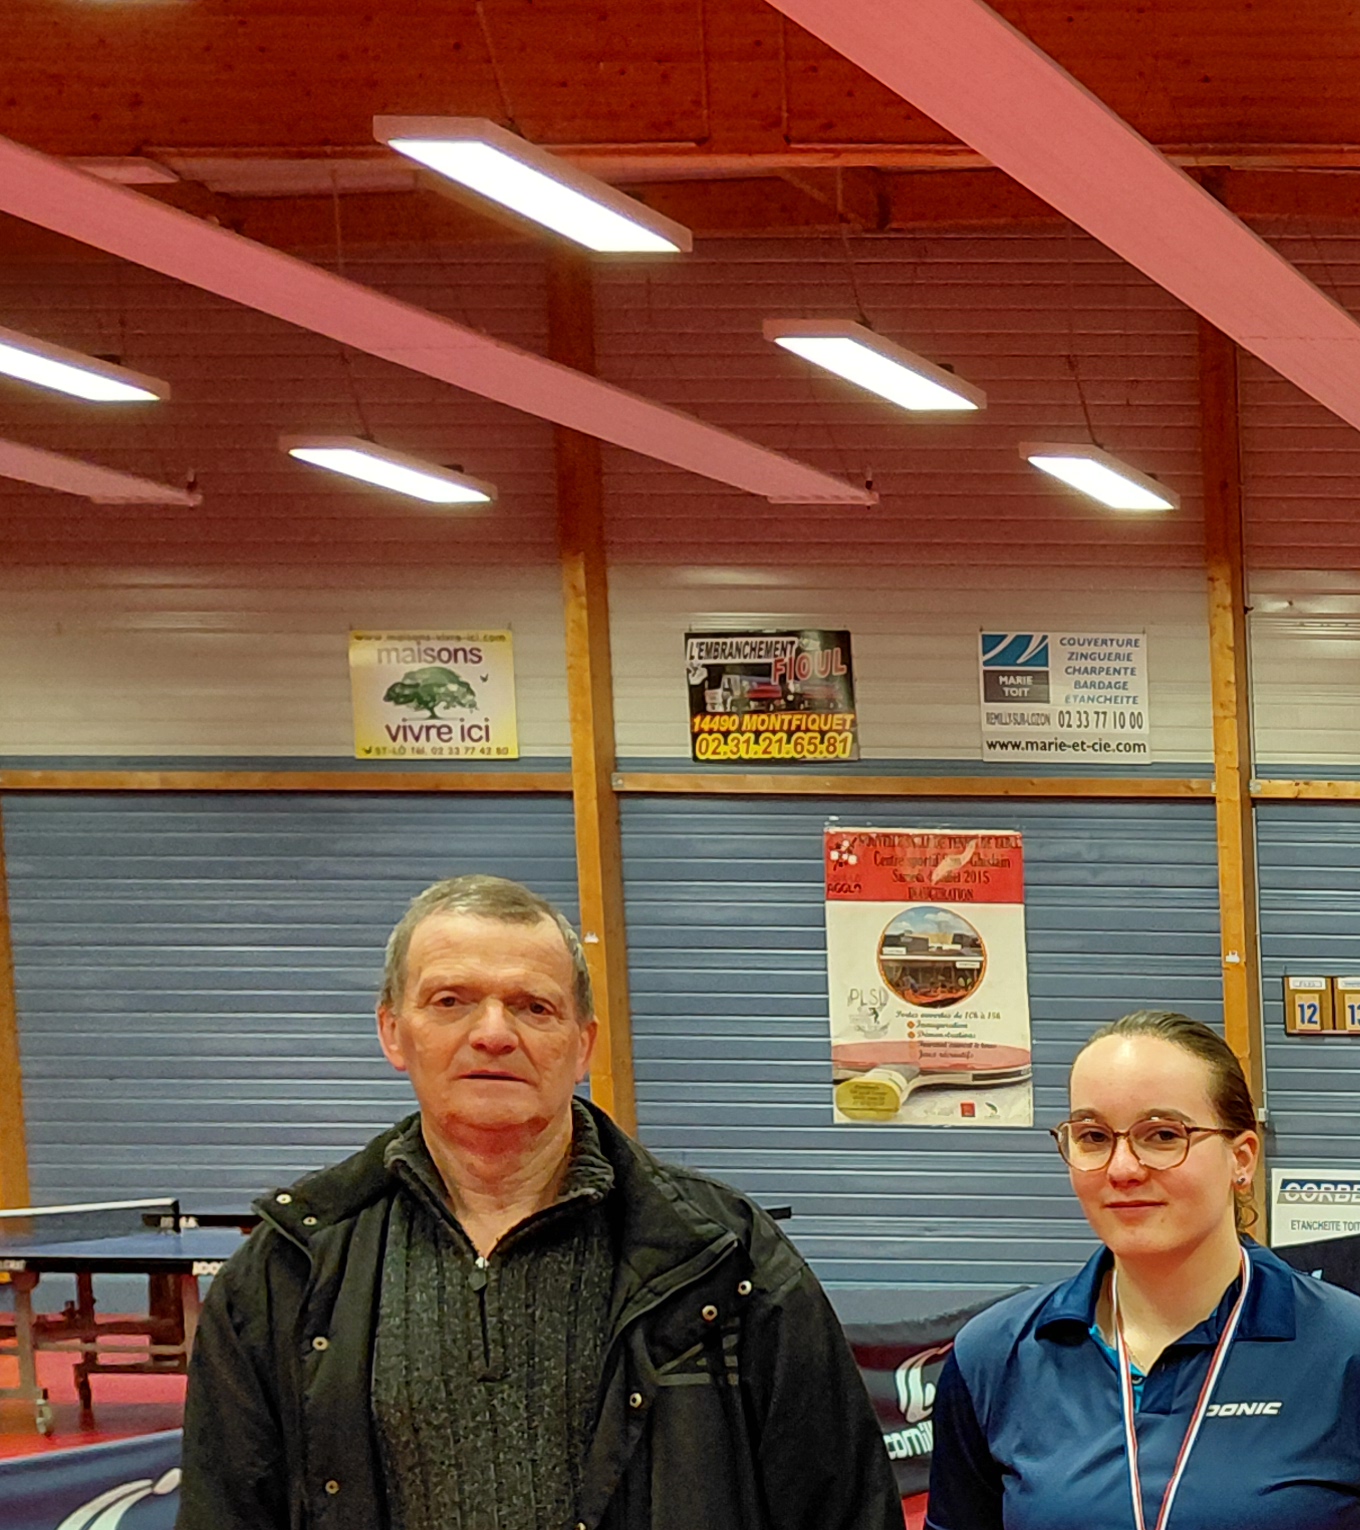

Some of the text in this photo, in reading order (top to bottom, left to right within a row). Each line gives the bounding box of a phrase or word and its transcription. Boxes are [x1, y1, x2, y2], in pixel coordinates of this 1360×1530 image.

[689, 638, 797, 661] L'EMBRANCHEMENT
[1059, 636, 1141, 649] COUVERTURE
[376, 640, 484, 665] maisons
[1067, 651, 1134, 663] ZINGUERIE
[773, 647, 847, 684] FIOUL
[1064, 665, 1137, 677] CHARPENTE
[999, 675, 1034, 686] MARIE
[1073, 680, 1129, 691] BARDAGE
[1002, 687, 1030, 697] TOIT
[1064, 694, 1140, 706] ETANCHEITE
[692, 713, 855, 733] 14490 MONTFIQUET
[1057, 710, 1144, 730] 02 33 77 10 00
[384, 716, 491, 744] vivre ici
[697, 735, 851, 757] 02.31.21.65.81
[985, 737, 1148, 754] www.marie-et-cie.com
[964, 871, 991, 884] 2015
[1297, 1002, 1319, 1025] 12
[1290, 1219, 1341, 1232] ETANCHEITE
[193, 1261, 226, 1276] JOO
